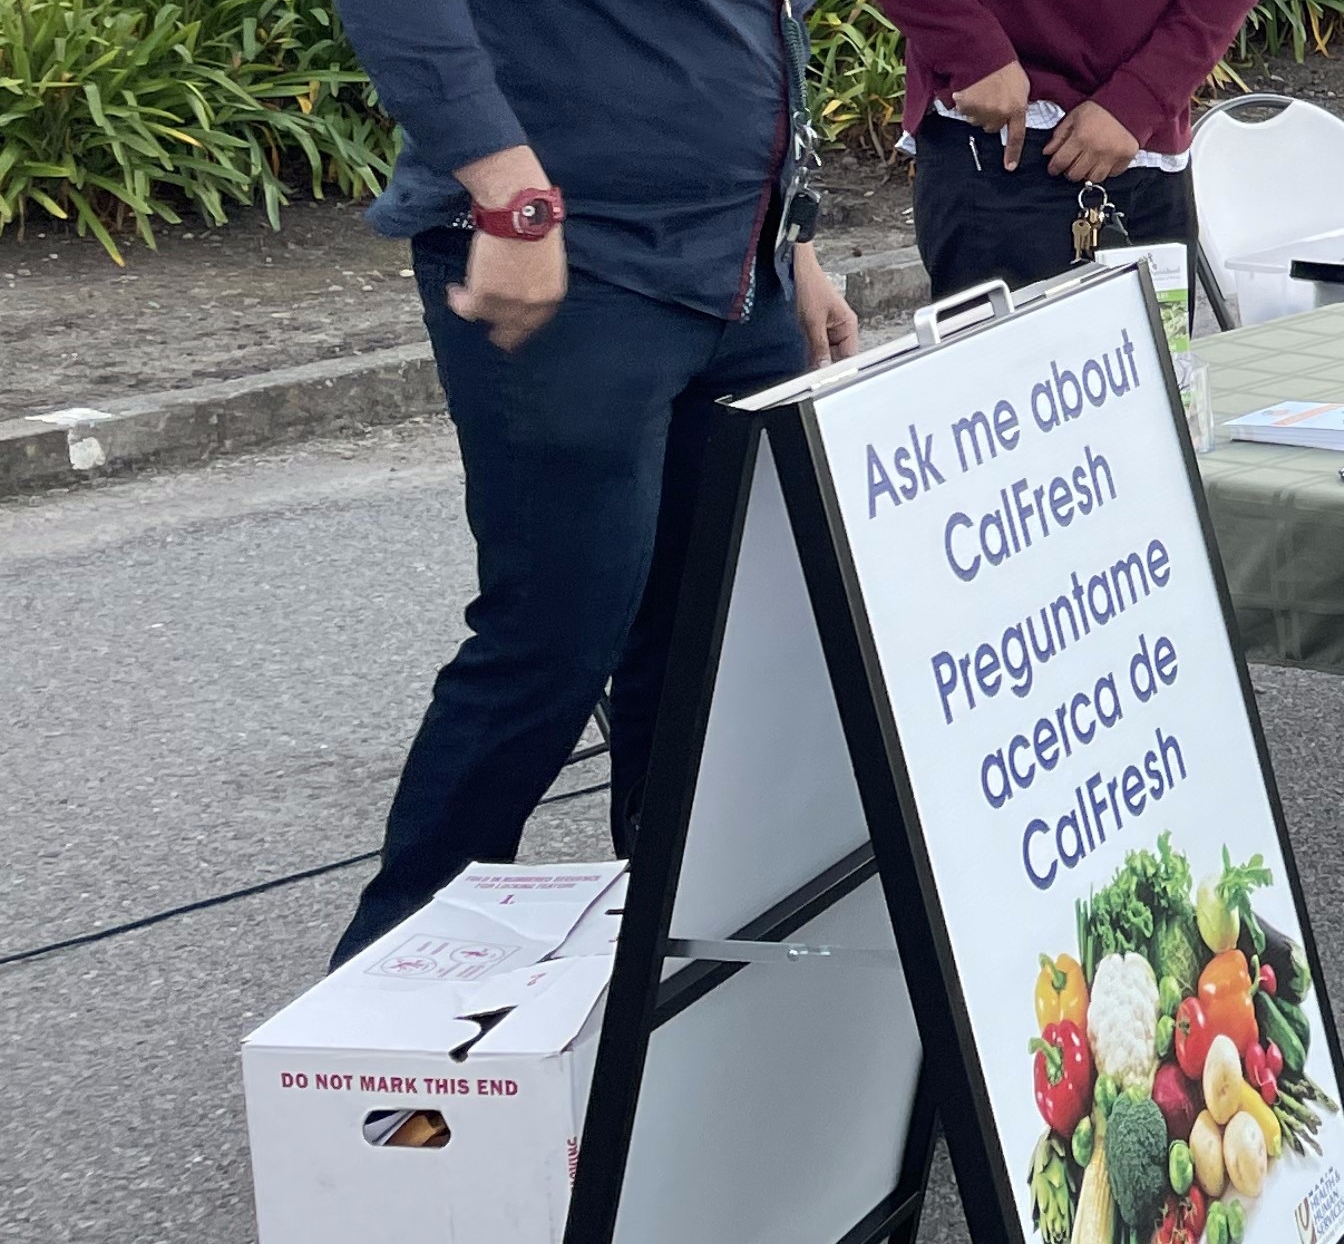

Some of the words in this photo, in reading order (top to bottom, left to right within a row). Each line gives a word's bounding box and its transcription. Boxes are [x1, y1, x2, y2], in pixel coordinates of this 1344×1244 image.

[866, 424, 946, 520] Ask
[951, 399, 1021, 473] me
[1031, 328, 1140, 433] about
[944, 445, 1117, 582] CalFresh
[931, 538, 1171, 724] Preguntame
[981, 675, 1122, 809] acerca
[1130, 634, 1178, 702] de
[1022, 729, 1187, 890] CalFresh
[281, 1072, 308, 1089] DO
[315, 1073, 353, 1090] NOT
[360, 1075, 418, 1094] MARK
[423, 1077, 470, 1095] THIS
[477, 1079, 519, 1097] END
